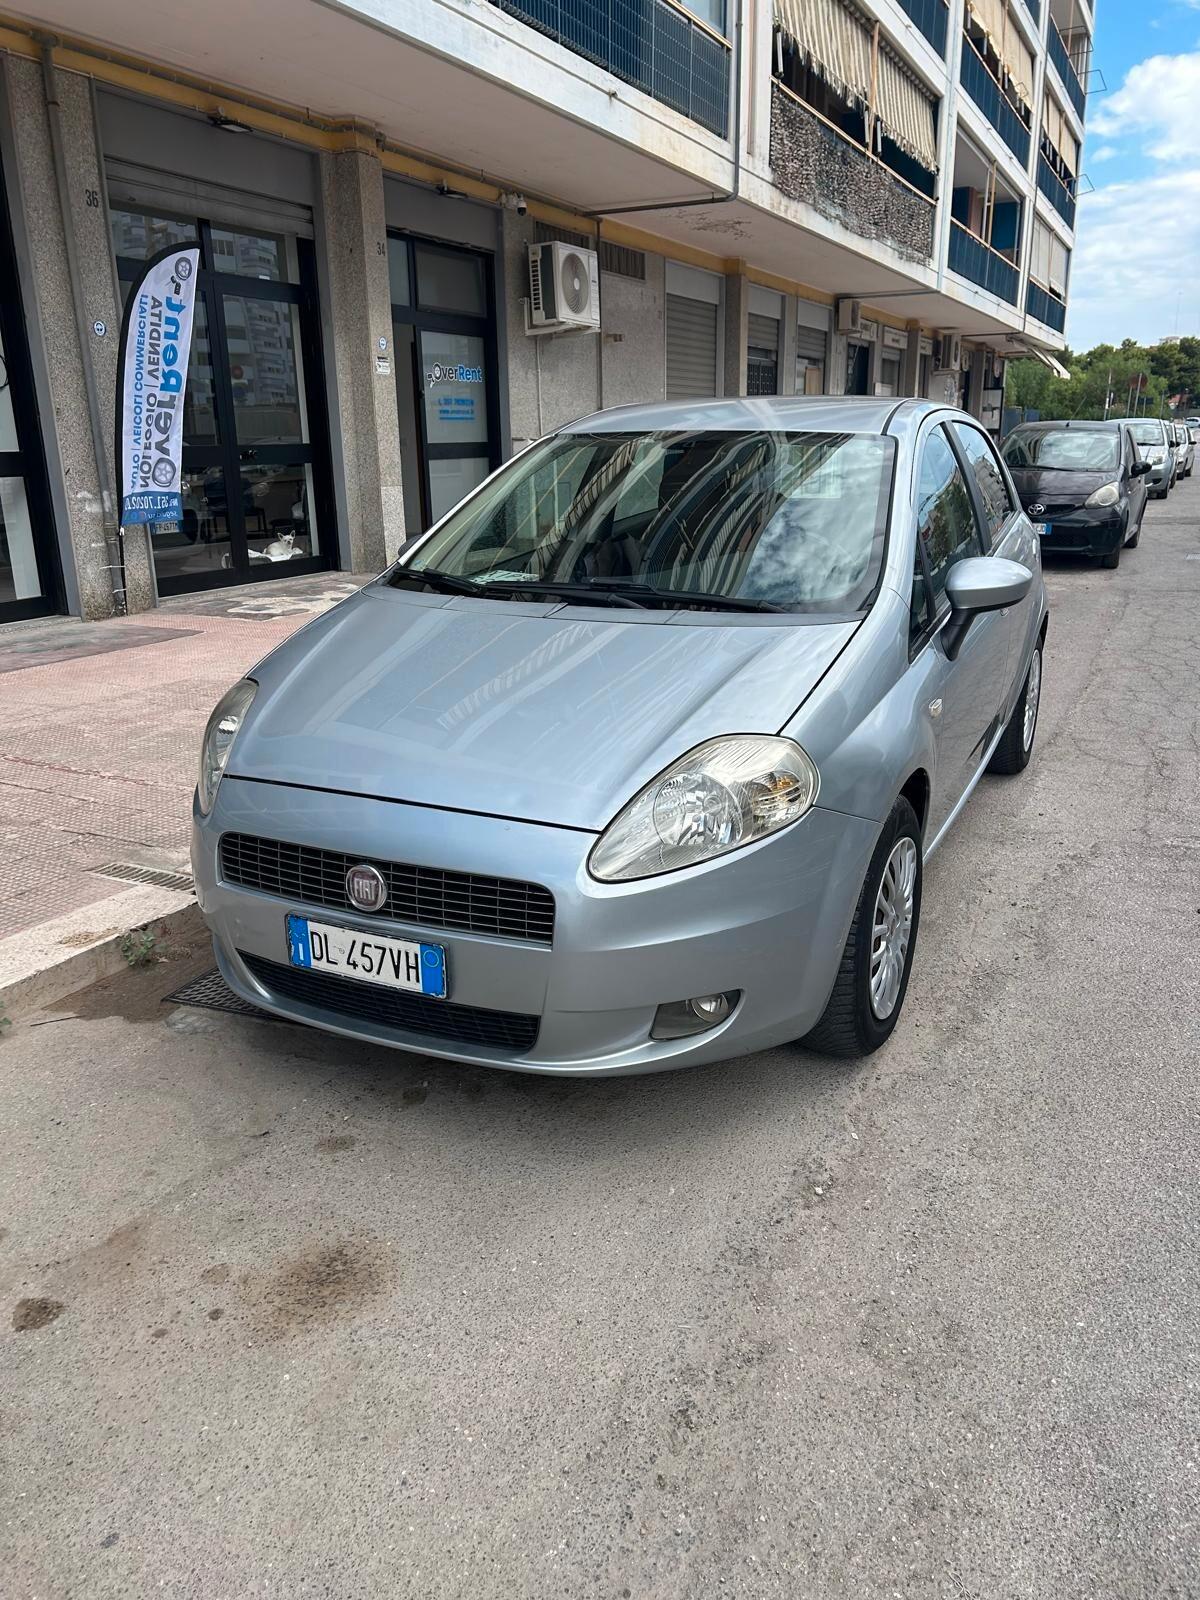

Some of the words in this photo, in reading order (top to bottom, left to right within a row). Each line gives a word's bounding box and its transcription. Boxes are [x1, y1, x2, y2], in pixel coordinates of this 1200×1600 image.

[85, 189, 99, 208] 36
[376, 242, 386, 257] 34
[433, 362, 482, 382] OverRent
[353, 878, 378, 900] FIAT
[310, 931, 338, 965] DL
[346, 939, 420, 983] 457VH
